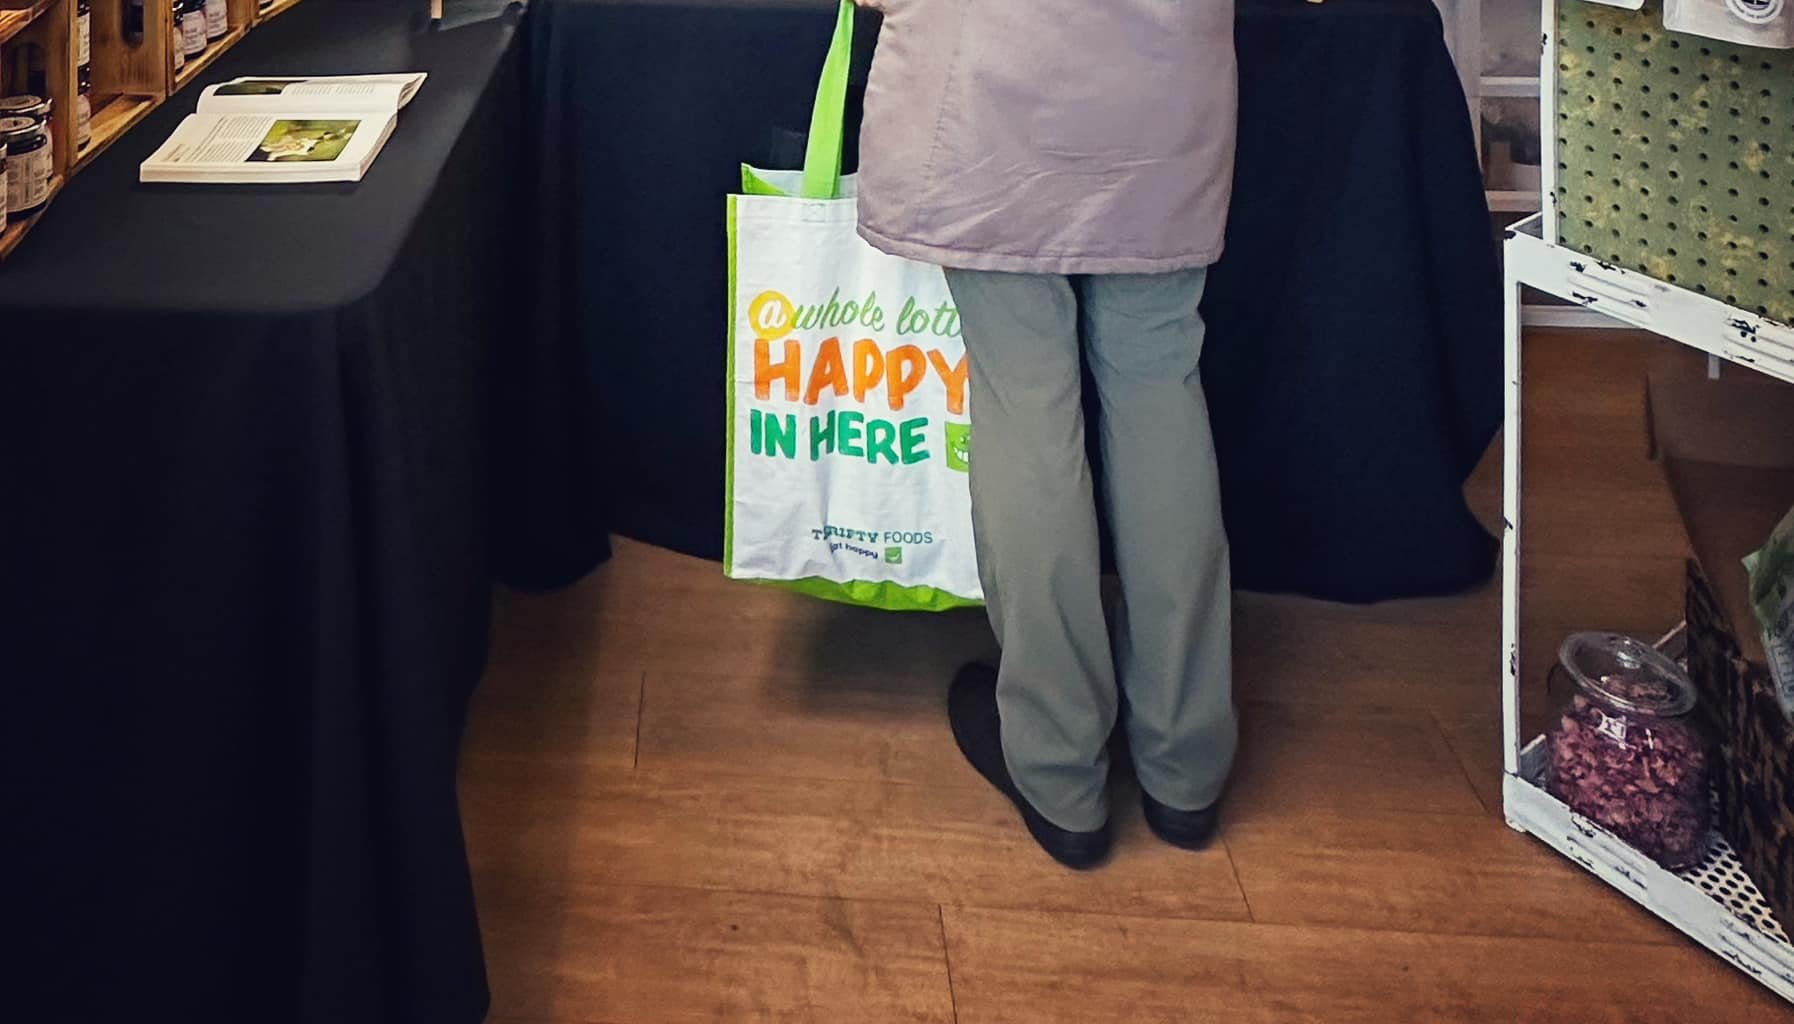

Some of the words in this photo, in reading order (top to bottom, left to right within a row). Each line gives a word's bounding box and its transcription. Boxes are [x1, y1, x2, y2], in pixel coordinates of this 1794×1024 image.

[791, 286, 885, 332] whole
[896, 295, 961, 338] lott
[754, 336, 970, 416] HAPPY
[750, 408, 797, 460] IN
[809, 409, 931, 466] HERE
[884, 531, 934, 545] FOODS
